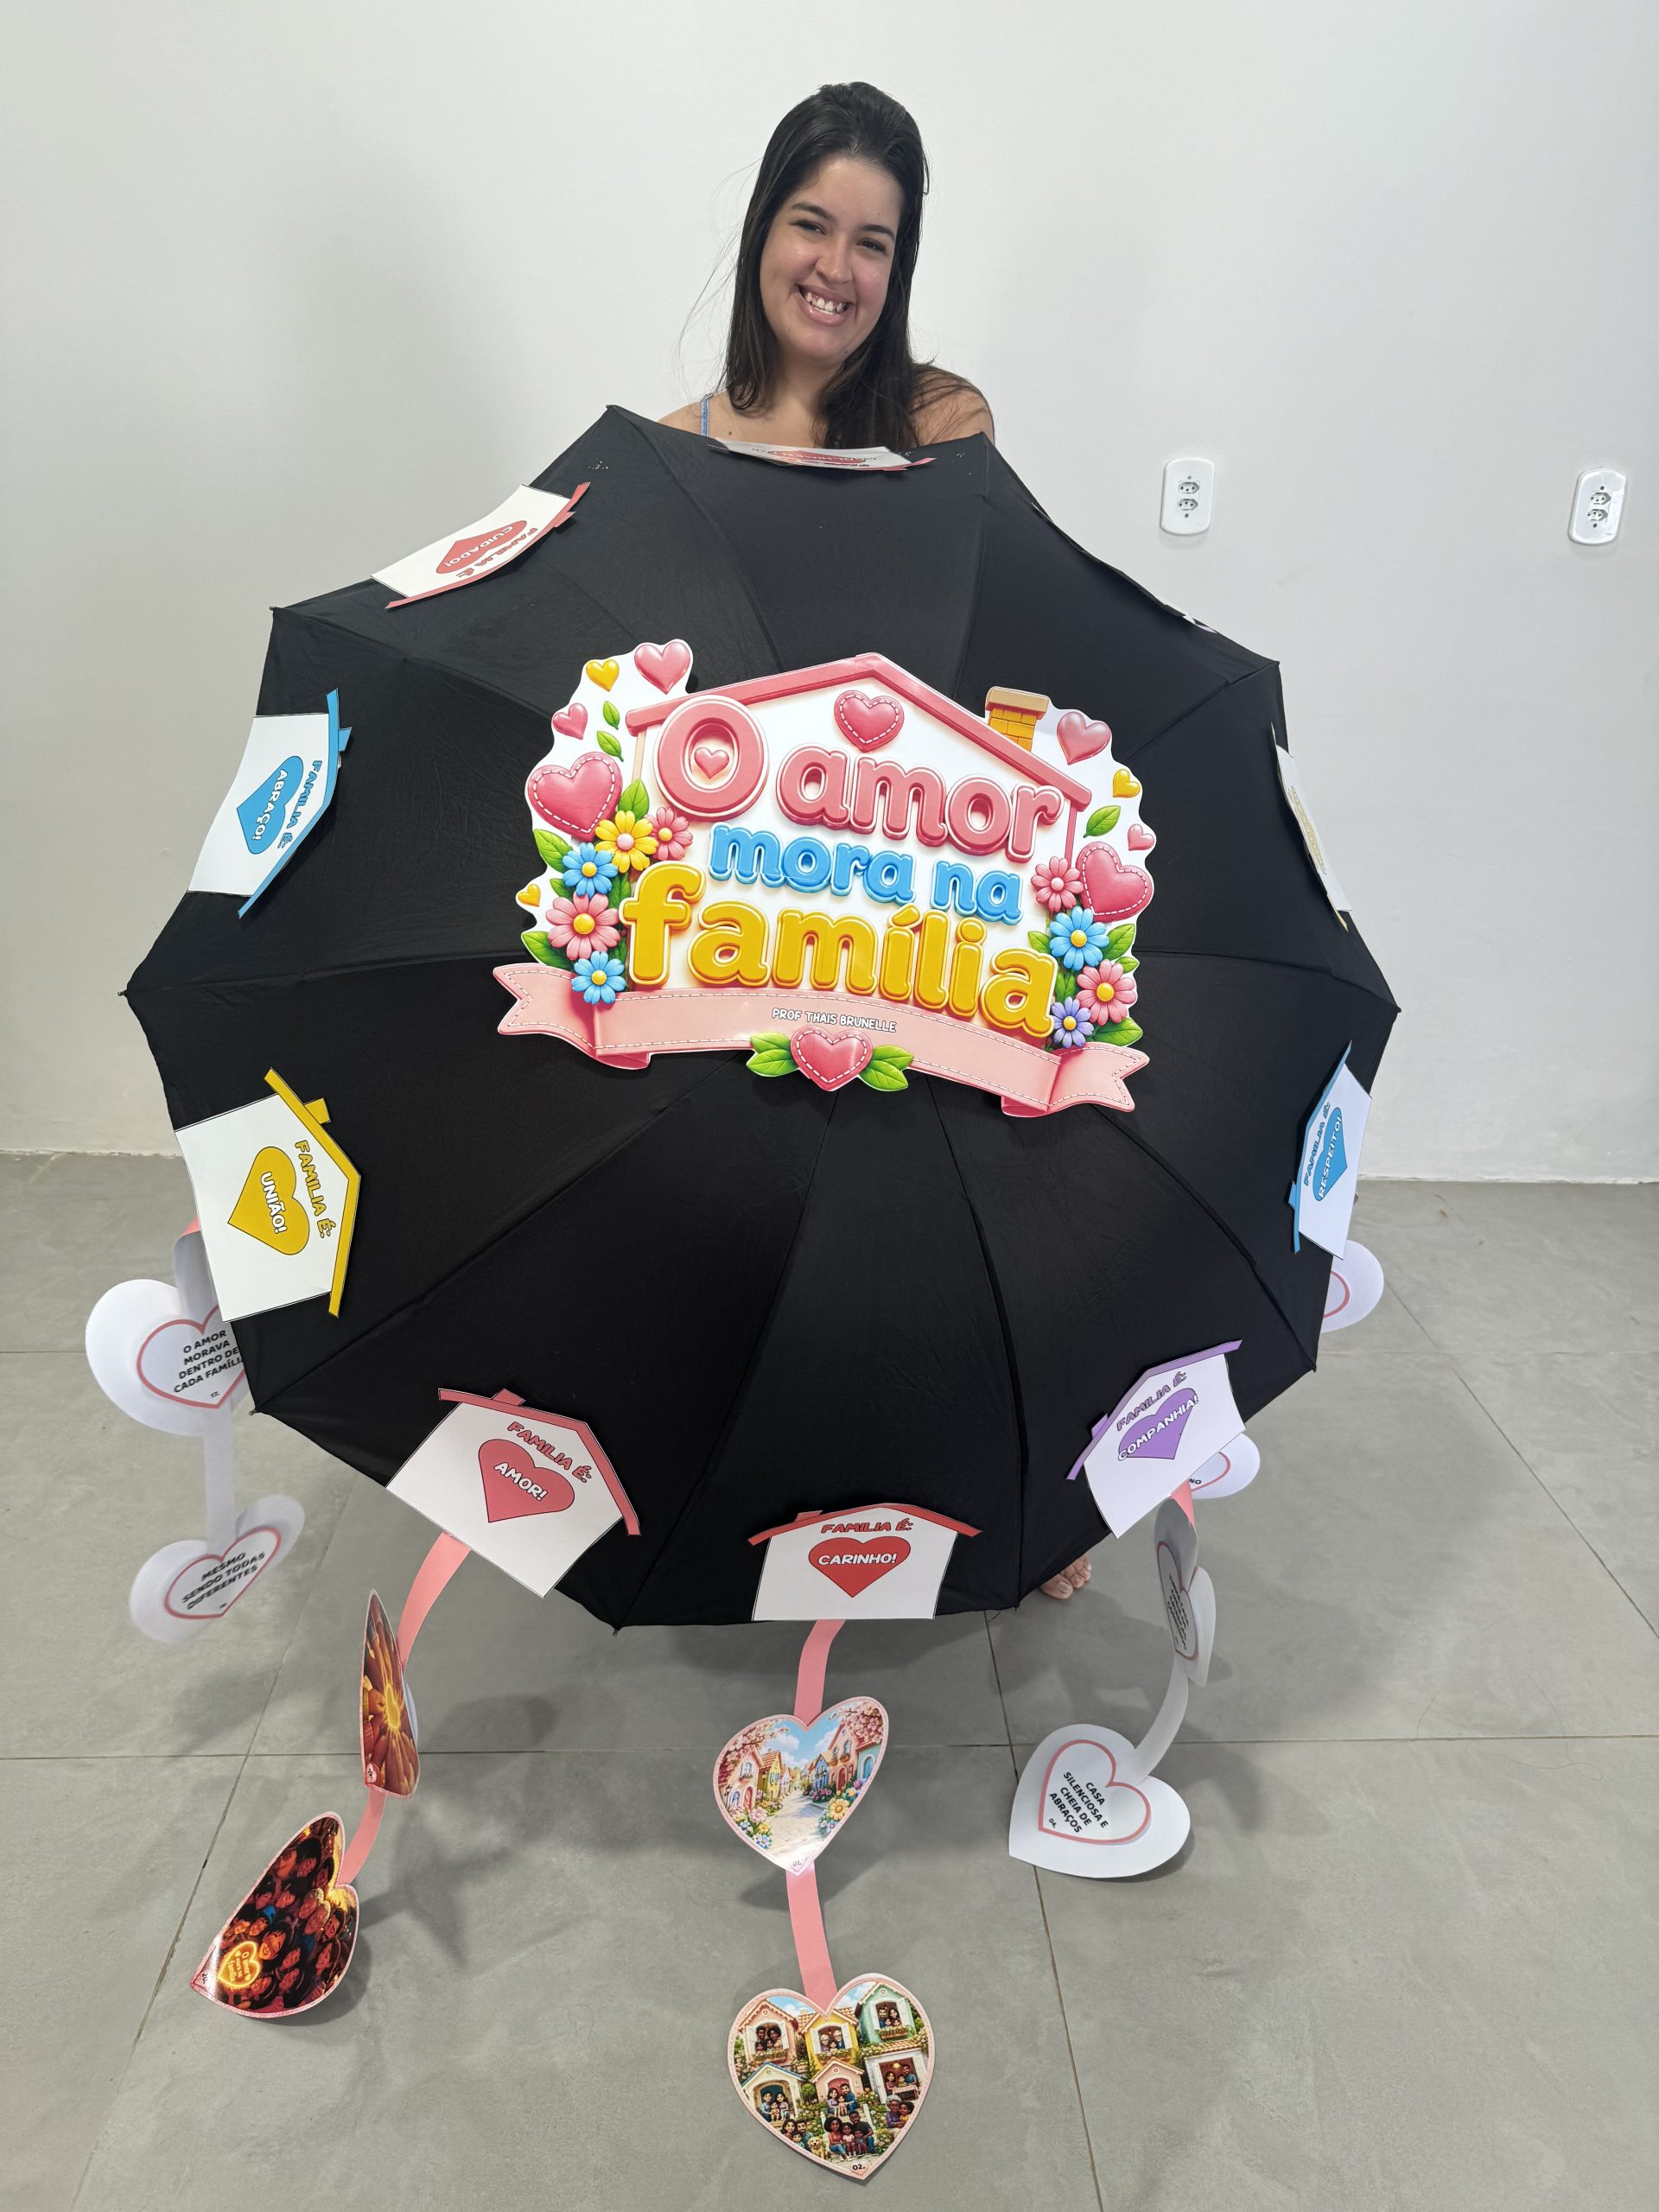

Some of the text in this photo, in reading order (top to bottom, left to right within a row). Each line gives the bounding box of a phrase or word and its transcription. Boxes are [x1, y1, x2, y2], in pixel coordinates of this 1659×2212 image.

[444, 526, 513, 568] CUIDADO!
[287, 760, 322, 829] FAMILIA
[655, 695, 1065, 862] O amor
[252, 769, 288, 841] ABRAÇO!
[709, 823, 1023, 925] mora na
[622, 861, 1058, 1038] família
[772, 1008, 897, 1033] PROF THAIS BRUNELLE
[1304, 1122, 1325, 1186] FAMILIA
[1319, 1116, 1342, 1198] RESPEITO!
[295, 1140, 327, 1217] FAMILIA
[260, 1172, 288, 1234] UNIÃO!
[184, 1340, 230, 1365] MORAVA
[194, 1330, 226, 1349] AMOR
[174, 1357, 242, 1393] CADA FAMÍLI
[178, 1346, 239, 1379] DENTRO DE
[1116, 1384, 1171, 1432] FAMILIA
[1117, 1395, 1199, 1461] COMPANHIA!
[506, 1421, 573, 1470] FAMILIA
[493, 1461, 548, 1501] AMOR!
[821, 1522, 891, 1534] FAMILIA
[201, 1552, 246, 1581] MESMO
[817, 1553, 898, 1566] CARINHO!
[182, 1574, 223, 1603] SENDO
[1049, 1793, 1082, 1833] ABRAÇOS
[1060, 1787, 1092, 1826] CHEIA DE
[1064, 1771, 1103, 1821] SILENCIOSA
[1085, 1783, 1105, 1805] CASA
